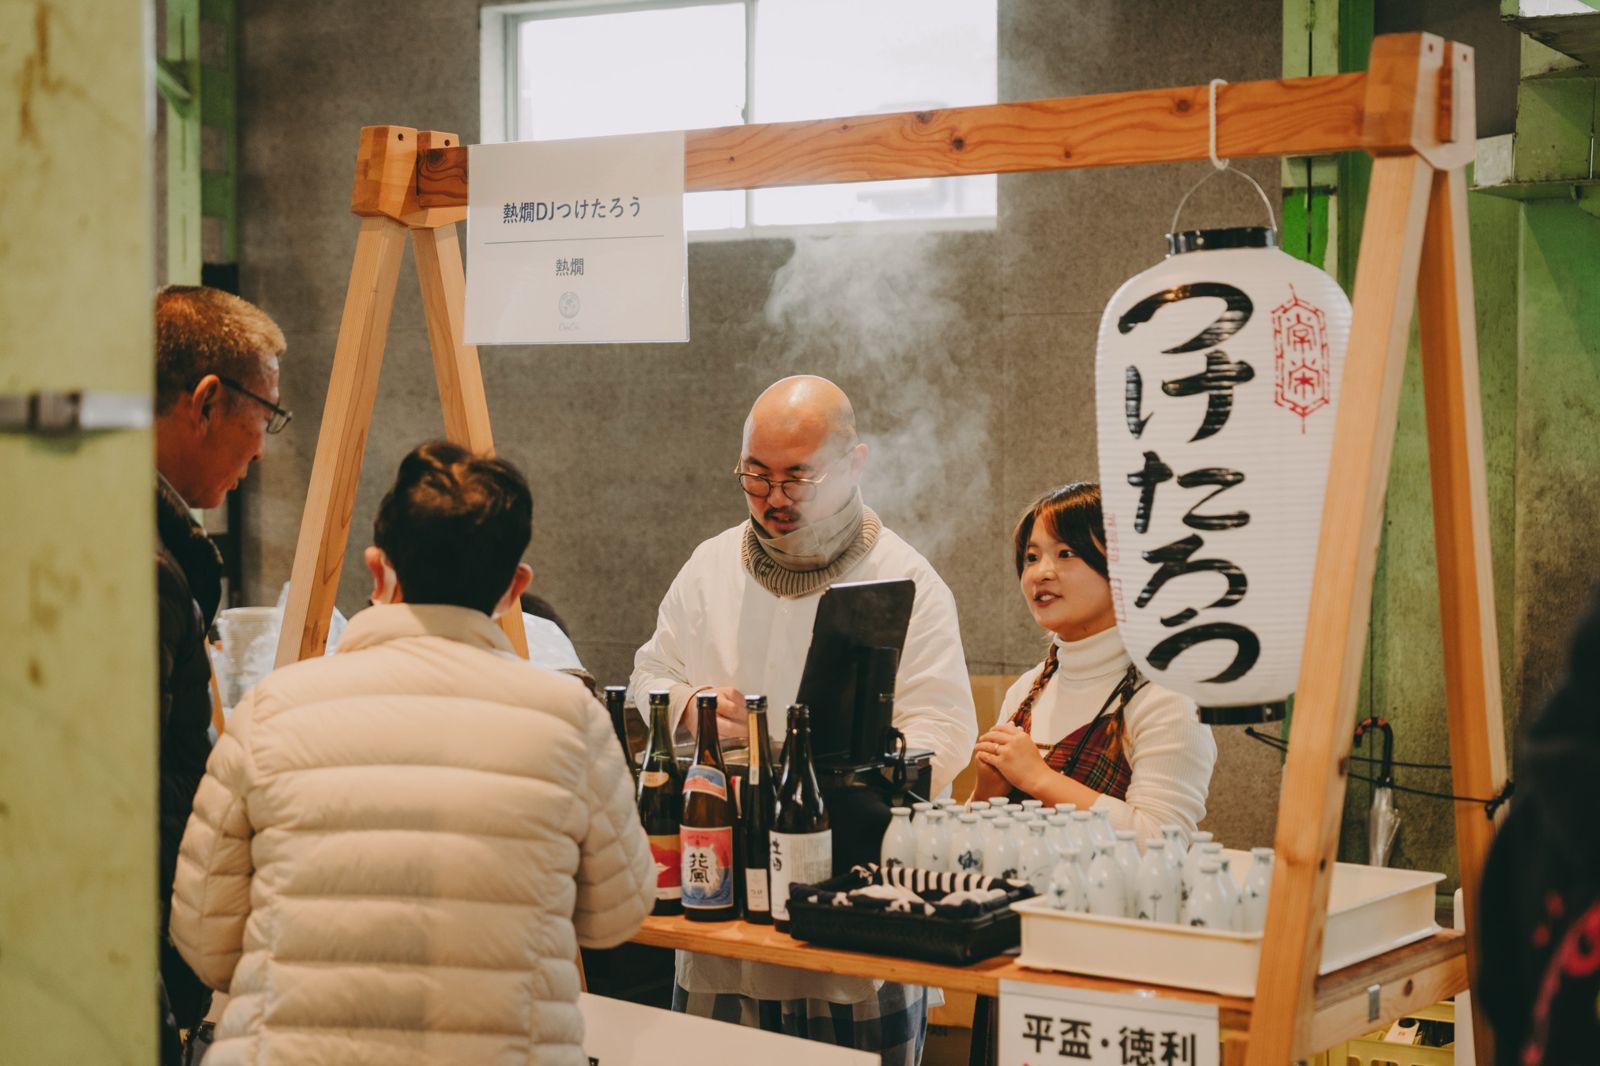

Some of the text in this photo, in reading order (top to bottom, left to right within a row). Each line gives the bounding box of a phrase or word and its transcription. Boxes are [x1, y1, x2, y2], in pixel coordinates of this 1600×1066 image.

[503, 196, 641, 224] 熱燗DJつけたろう
[555, 257, 584, 276] 熱燗
[1118, 282, 1261, 684] つけたろう
[1022, 1014, 1196, 1066] 平盃・徳利
